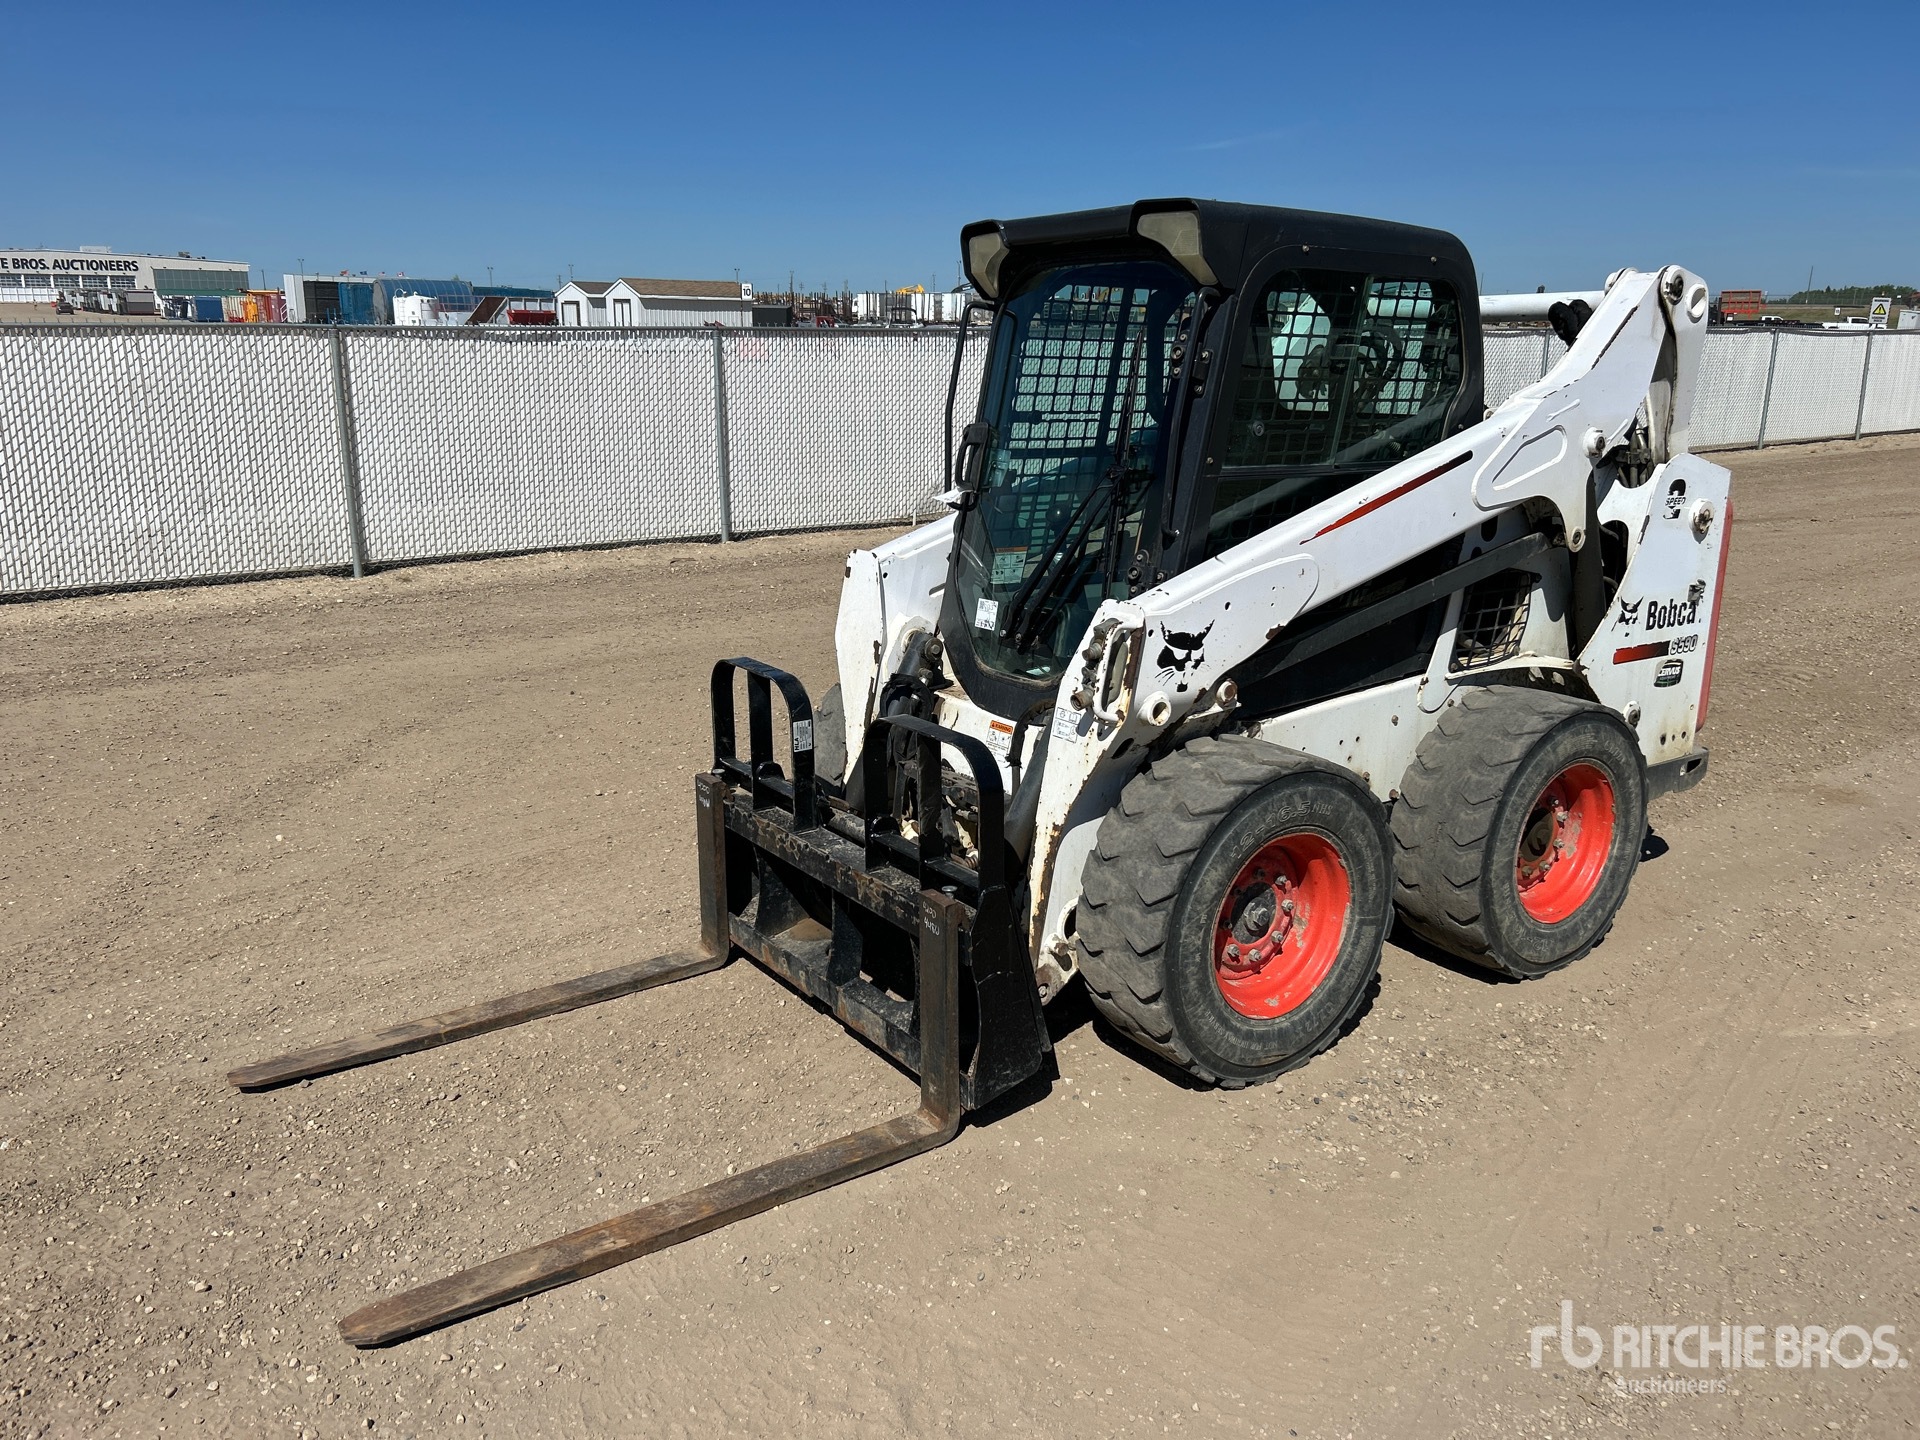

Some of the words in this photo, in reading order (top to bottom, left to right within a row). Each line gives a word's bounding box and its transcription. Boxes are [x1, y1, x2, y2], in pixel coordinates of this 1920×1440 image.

[12, 258, 50, 270] BROS.
[52, 259, 139, 272] AUCTIONEERS
[743, 288, 751, 296] 10
[1665, 496, 1686, 506] SPEED
[1645, 598, 1702, 631] Bobca
[1669, 634, 1698, 655] S590
[1311, 801, 1334, 817] NHS
